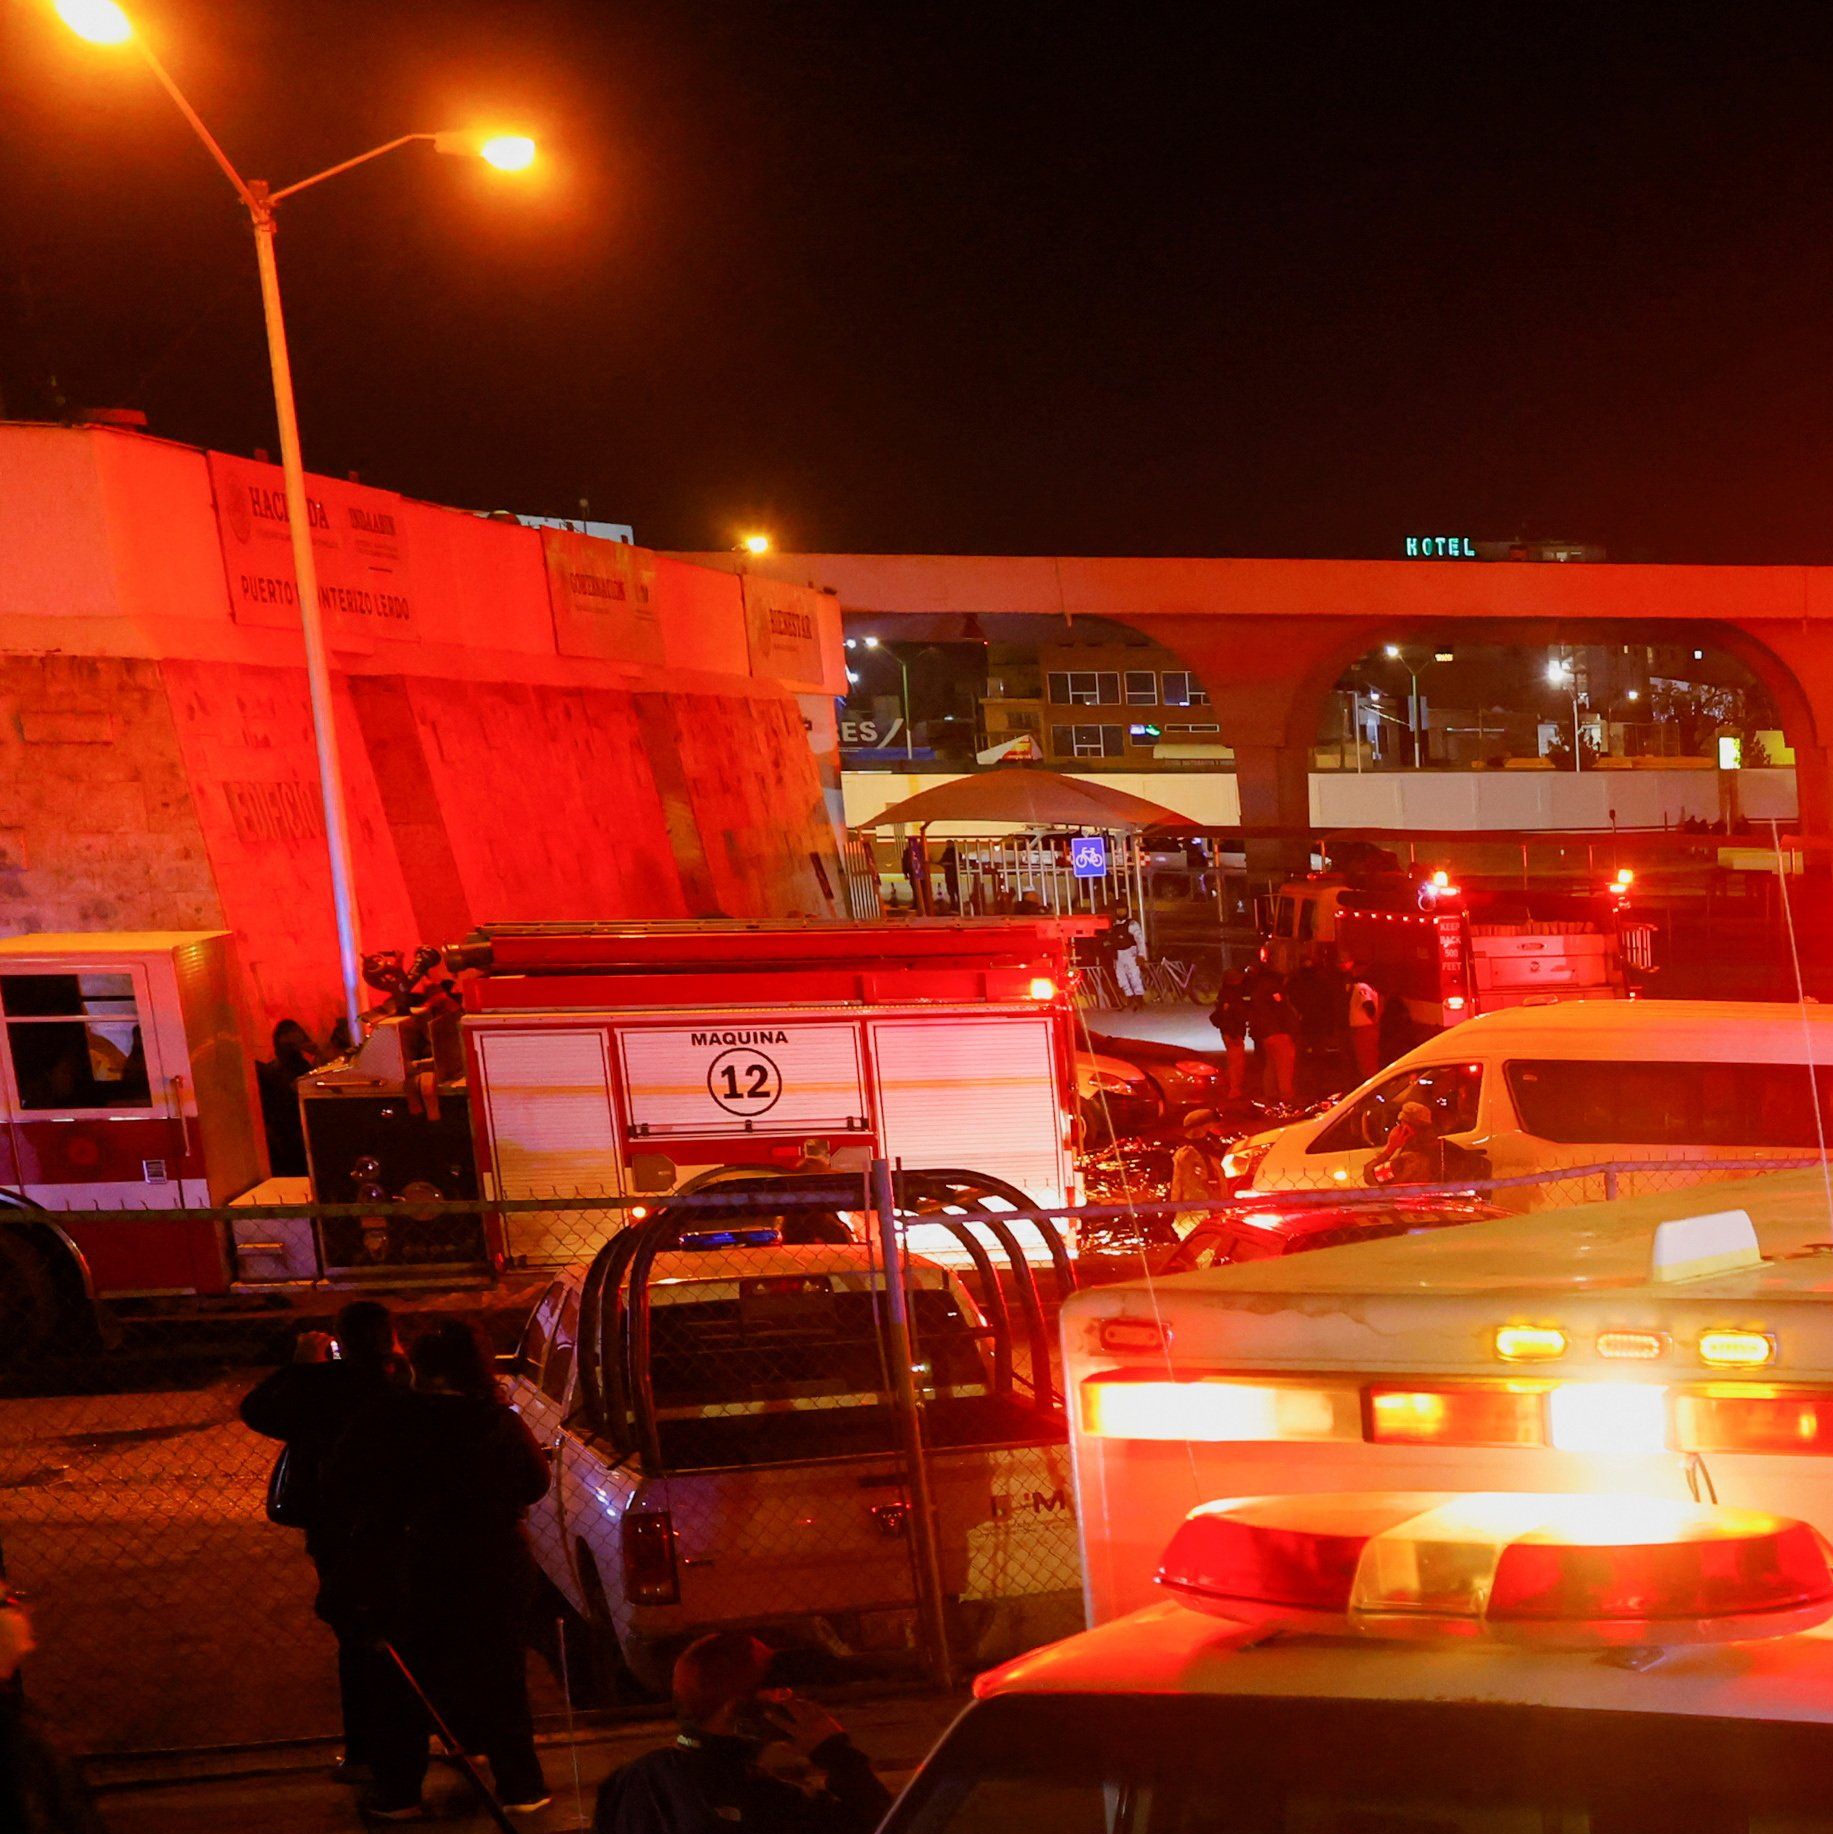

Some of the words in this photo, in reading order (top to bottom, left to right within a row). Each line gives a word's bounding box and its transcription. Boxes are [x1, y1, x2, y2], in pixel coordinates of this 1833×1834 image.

[249, 487, 329, 529] HACIDA
[1406, 537, 1475, 556] HOTEL
[241, 575, 293, 605] PUERTO
[374, 596, 409, 620] LERDO
[1440, 922, 1460, 931] KEEP
[1440, 936, 1461, 945] BACK
[1442, 962, 1461, 971] FEET
[691, 1031, 788, 1046] MAQUINA
[721, 1064, 770, 1098] 12
